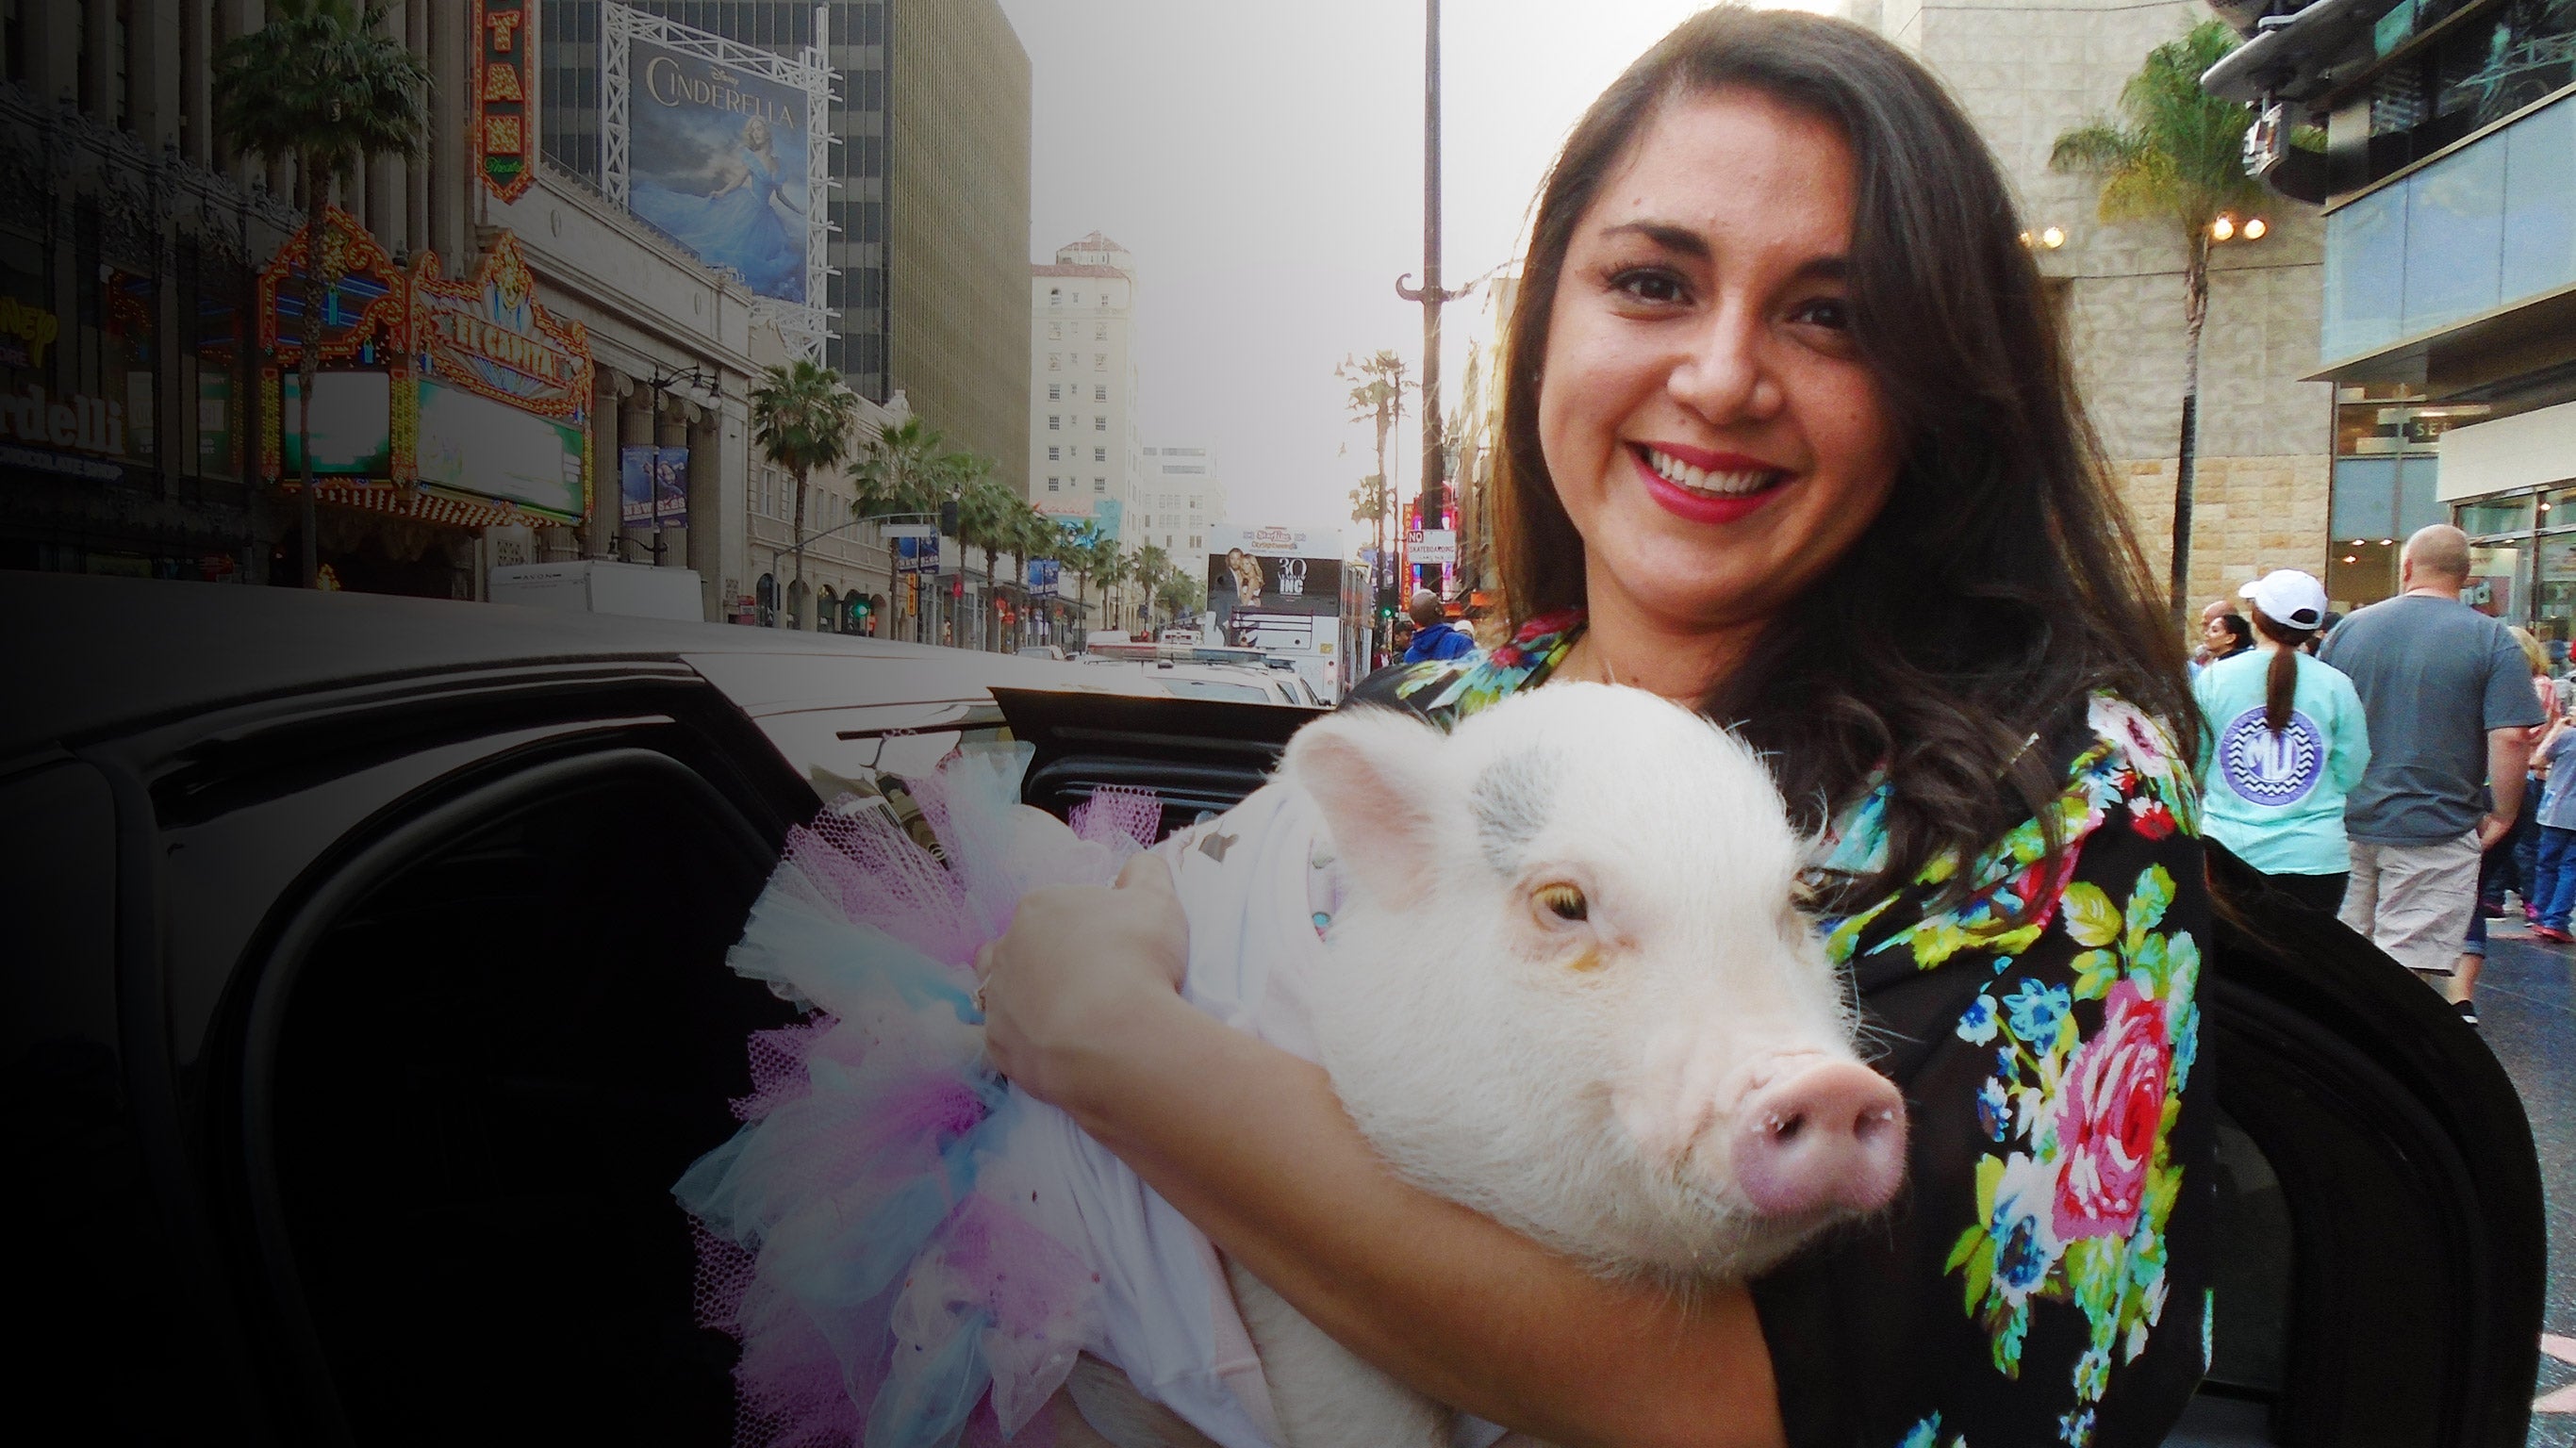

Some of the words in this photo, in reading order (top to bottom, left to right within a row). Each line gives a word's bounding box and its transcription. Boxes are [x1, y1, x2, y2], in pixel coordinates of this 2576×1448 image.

[646, 57, 794, 129] CINDERELLA
[483, 326, 556, 379] CAPITA
[1409, 532, 1423, 543] NO
[522, 572, 553, 581] AVON
[1280, 579, 1304, 593] INC
